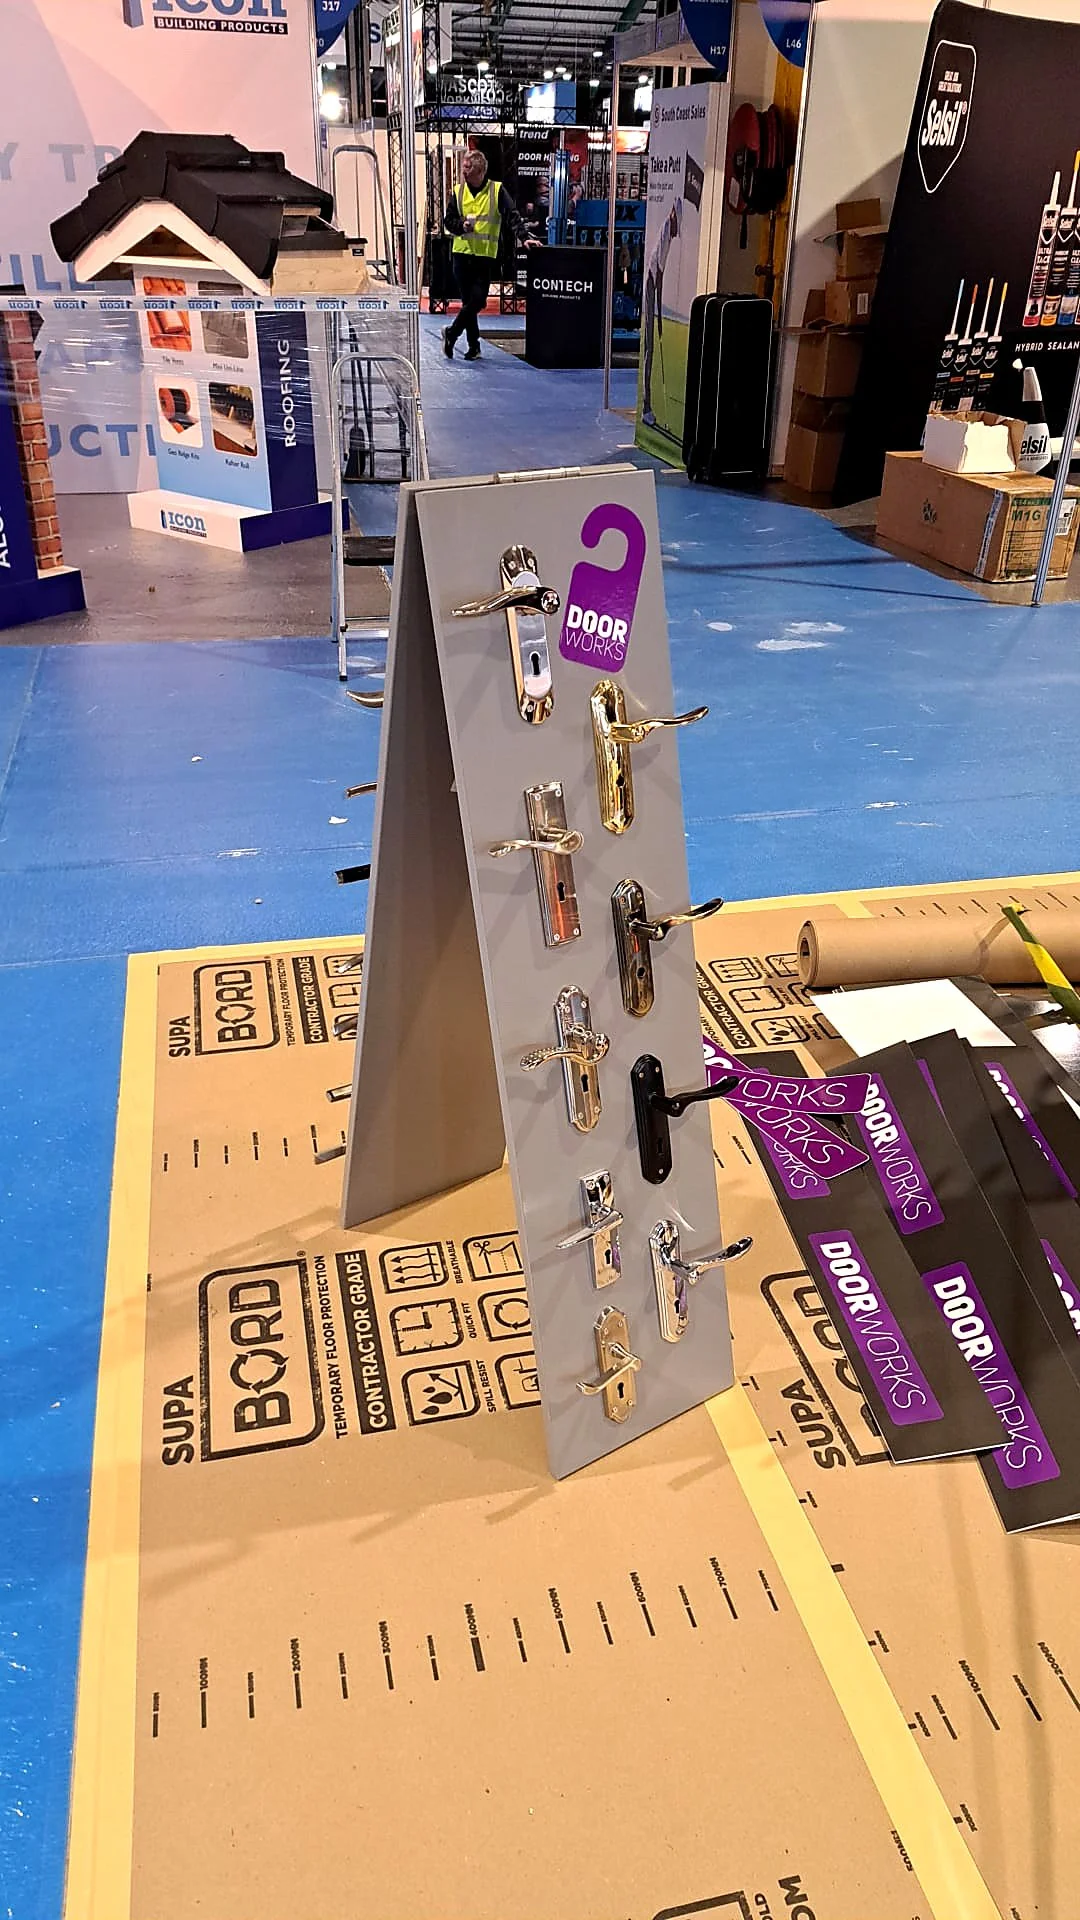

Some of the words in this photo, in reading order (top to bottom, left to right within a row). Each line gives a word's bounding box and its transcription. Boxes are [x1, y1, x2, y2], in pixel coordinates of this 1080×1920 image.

[322, 1, 340, 11] J17
[158, 18, 216, 30] BUILDING
[221, 22, 285, 33] PRODUCTS
[710, 46, 727, 56] H17
[786, 38, 802, 49] L46
[661, 107, 675, 121] South
[676, 106, 690, 120] Coast
[691, 104, 706, 119] Sales
[921, 99, 963, 146] Selsil
[518, 152, 542, 161] DOOR
[650, 157, 664, 173] Take
[664, 161, 668, 173] a
[533, 278, 593, 293] CONTECH
[1015, 342, 1044, 352] HYBRID
[278, 340, 298, 448] ROOFING
[1020, 435, 1048, 455] elsil
[1011, 509, 1041, 521] M1G
[567, 604, 628, 644] DOOR
[565, 627, 625, 661] WORKS
[276, 958, 289, 991] PROTECTION
[298, 957, 314, 984] GRADE
[280, 992, 292, 1010] FLOOR
[303, 984, 323, 1042] CONTRACTOR
[702, 987, 751, 1048] CONTRACTOR
[168, 1015, 191, 1058] SUPA
[284, 1010, 297, 1047] TEMPORARY
[745, 1103, 844, 1164] ORKS
[446, 1239, 464, 1284] BREATHABLE
[313, 1255, 335, 1323] PROTECTION
[344, 1252, 368, 1305] GRADE
[461, 1302, 472, 1316] FIT
[321, 1322, 340, 1361] FLOOR
[464, 1317, 477, 1339] QUICK
[354, 1305, 388, 1429] CONTRACTOR
[476, 1359, 491, 1390] RESIST
[324, 1362, 349, 1440] TEMPORARY
[482, 1390, 497, 1413] SPILL
[161, 1375, 195, 1466] SUPA
[780, 1378, 847, 1470] SUPA
[629, 1571, 646, 1603] 600MM
[709, 1556, 727, 1588] 700MM
[464, 1603, 478, 1636] 400MM
[548, 1587, 563, 1619] 500MM
[290, 1638, 301, 1672] 200MM
[1037, 1641, 1064, 1676] 200MM
[200, 1657, 208, 1691] 100MM
[958, 1660, 981, 1693] 100MM
